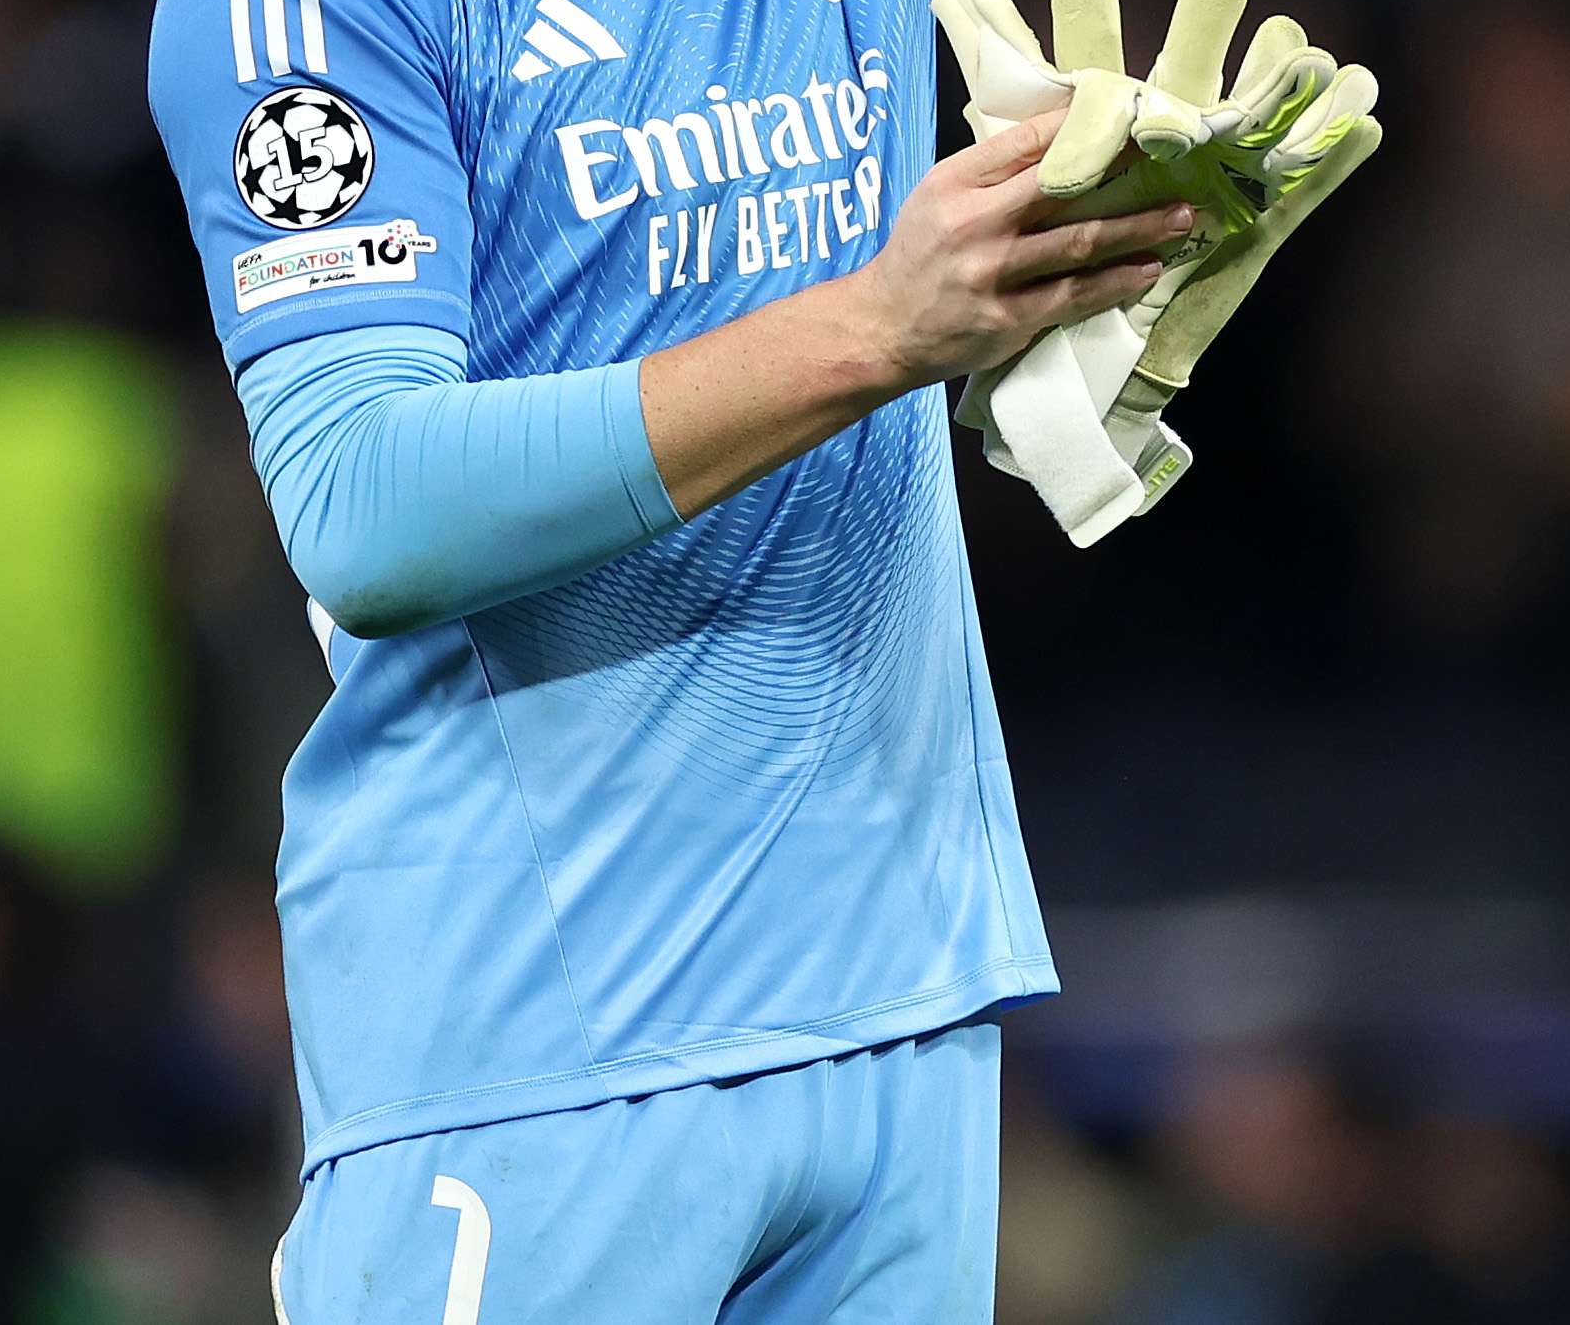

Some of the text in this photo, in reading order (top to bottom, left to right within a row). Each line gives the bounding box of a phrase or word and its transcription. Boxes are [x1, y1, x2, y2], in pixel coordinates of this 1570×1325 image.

[267, 125, 335, 191] 15
[357, 238, 432, 266] 10 YEARS
[648, 155, 882, 296] FLY BETTER
[237, 253, 263, 271] UEFA
[238, 250, 355, 291] FOUNDATION
[430, 1174, 492, 1325] 1
